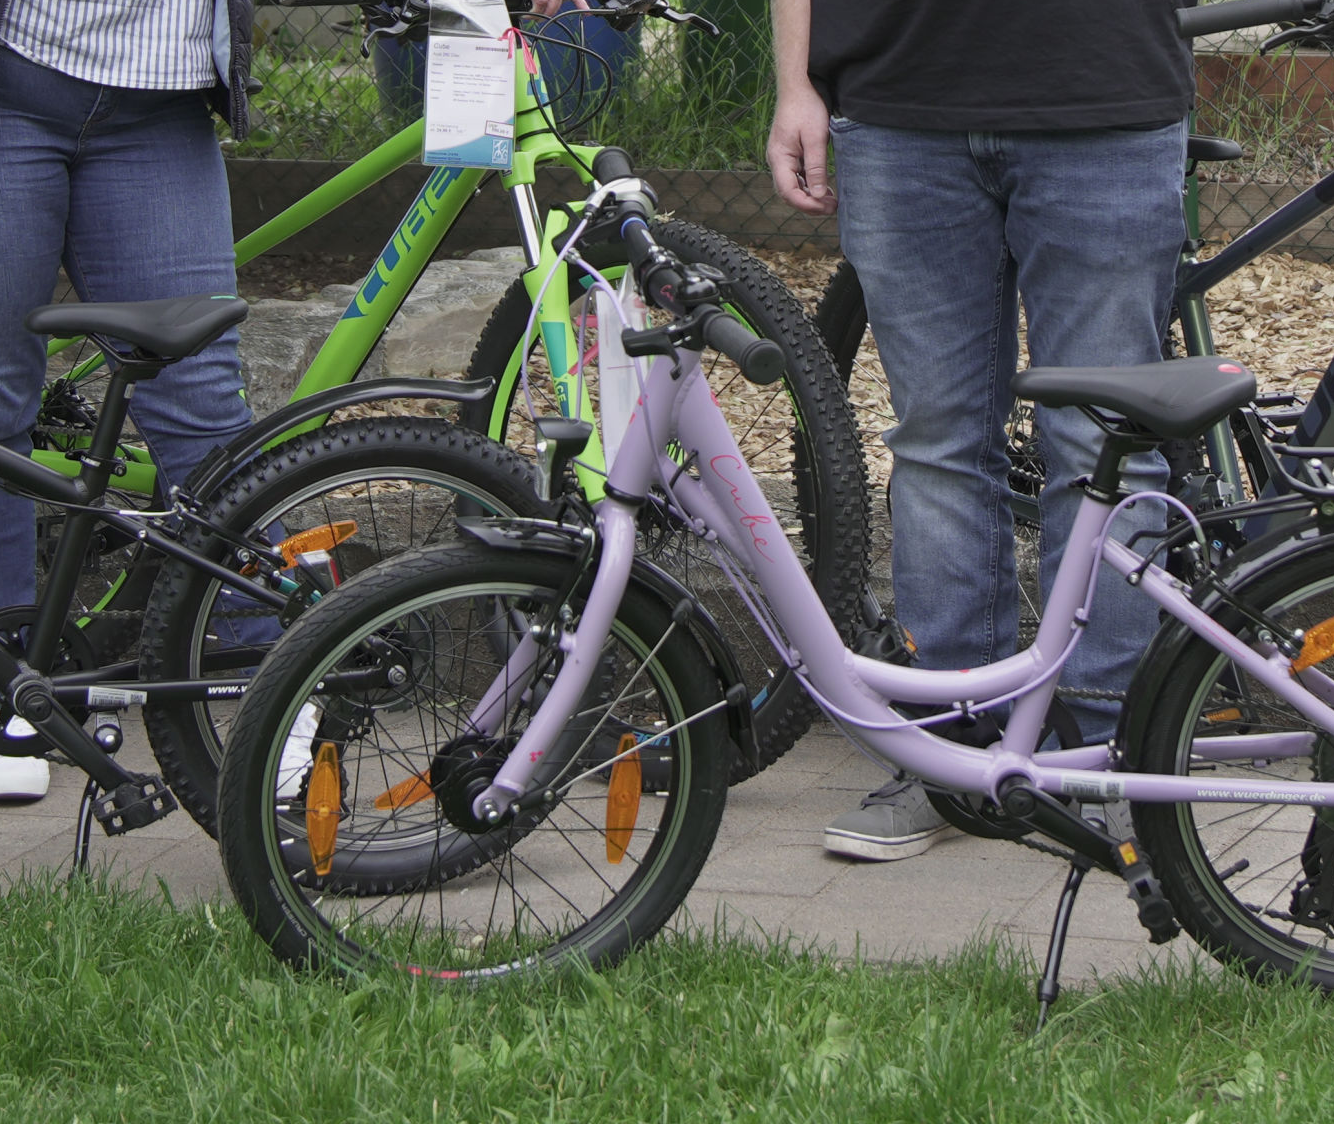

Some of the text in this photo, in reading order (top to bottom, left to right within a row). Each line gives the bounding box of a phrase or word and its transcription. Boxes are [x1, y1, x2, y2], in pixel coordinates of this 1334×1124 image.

[349, 165, 461, 317] CUBE
[710, 454, 776, 564] Cube
[1196, 788, 1327, 803] www.wuerdinger.de
